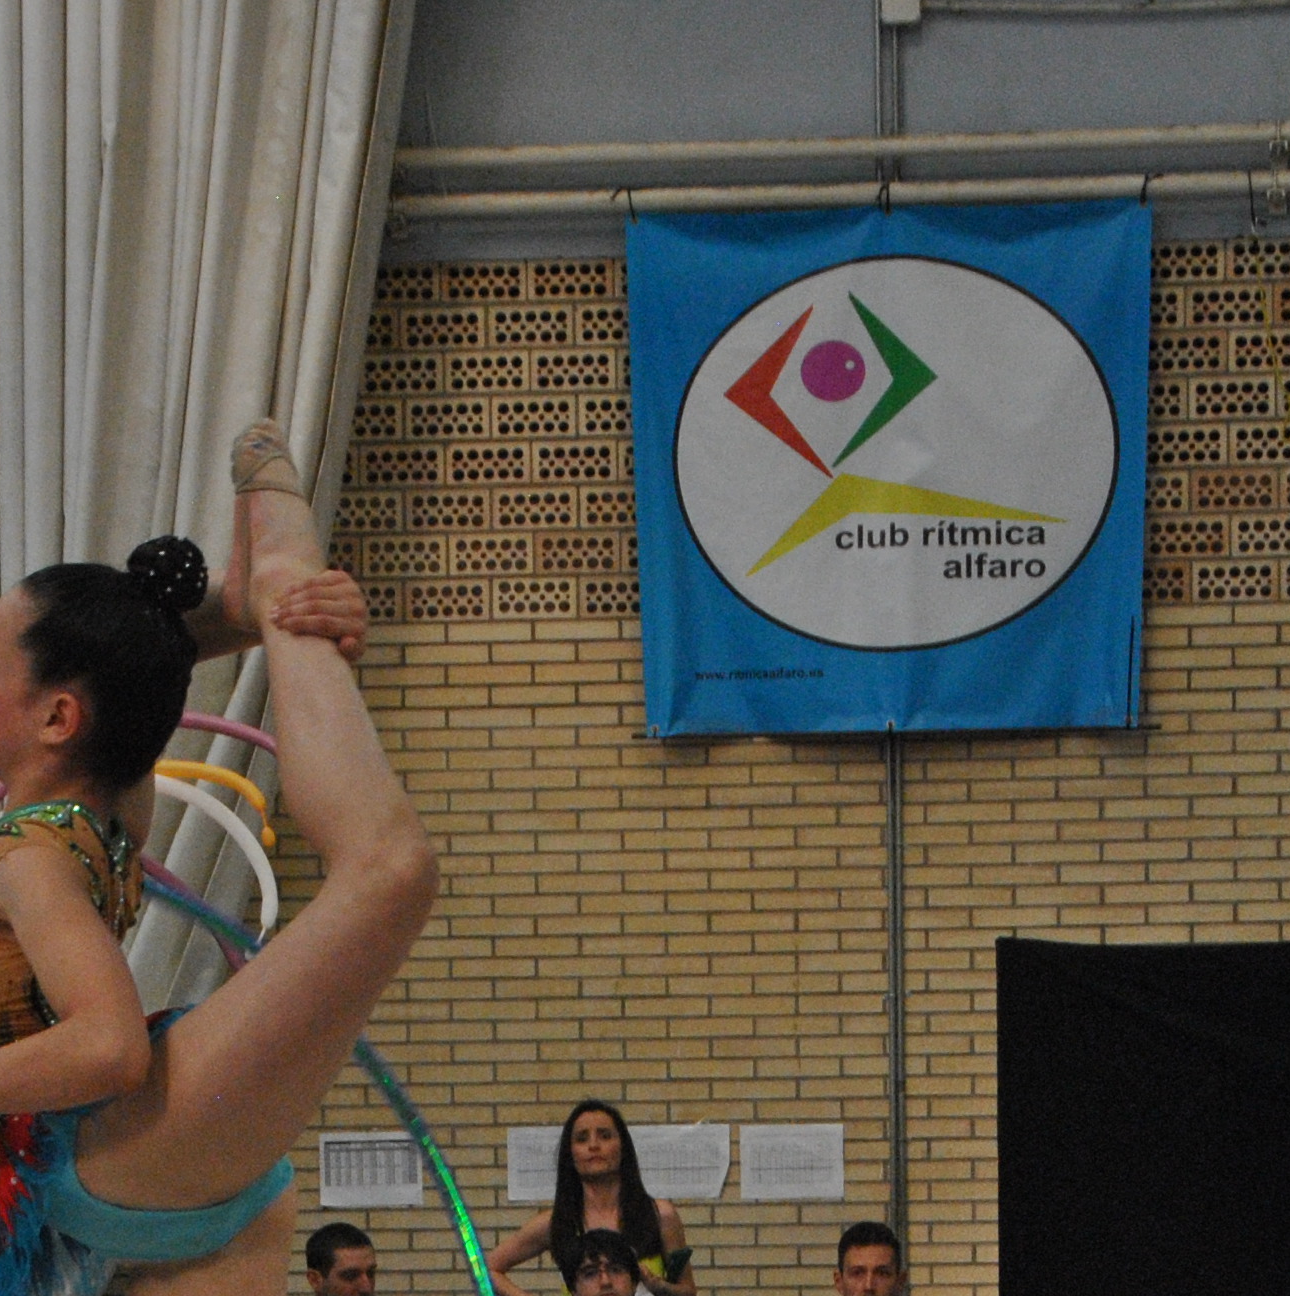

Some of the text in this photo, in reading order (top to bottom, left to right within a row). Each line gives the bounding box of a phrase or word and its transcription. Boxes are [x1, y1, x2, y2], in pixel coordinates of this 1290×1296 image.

[835, 519, 1046, 549] club rítmica
[943, 552, 1047, 579] alfaro
